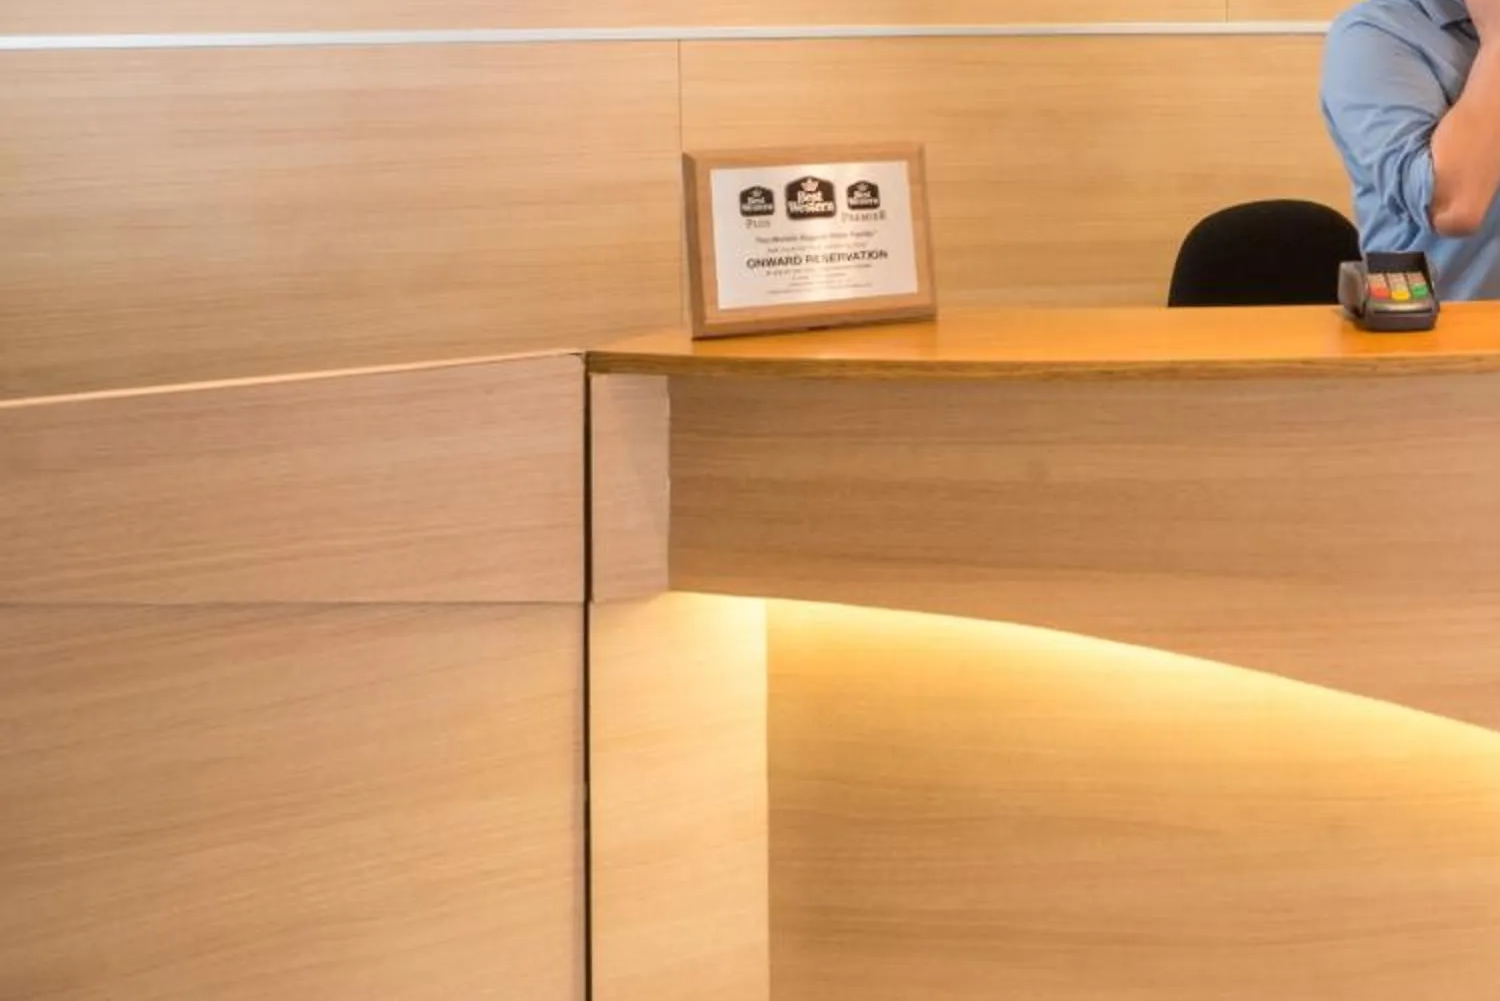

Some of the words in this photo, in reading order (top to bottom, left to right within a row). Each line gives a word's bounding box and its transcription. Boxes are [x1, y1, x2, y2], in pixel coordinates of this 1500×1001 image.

[797, 190, 823, 203] Best
[788, 201, 835, 214] Western
[746, 255, 802, 268] ONWARD
[805, 249, 888, 263] RESERVATION
